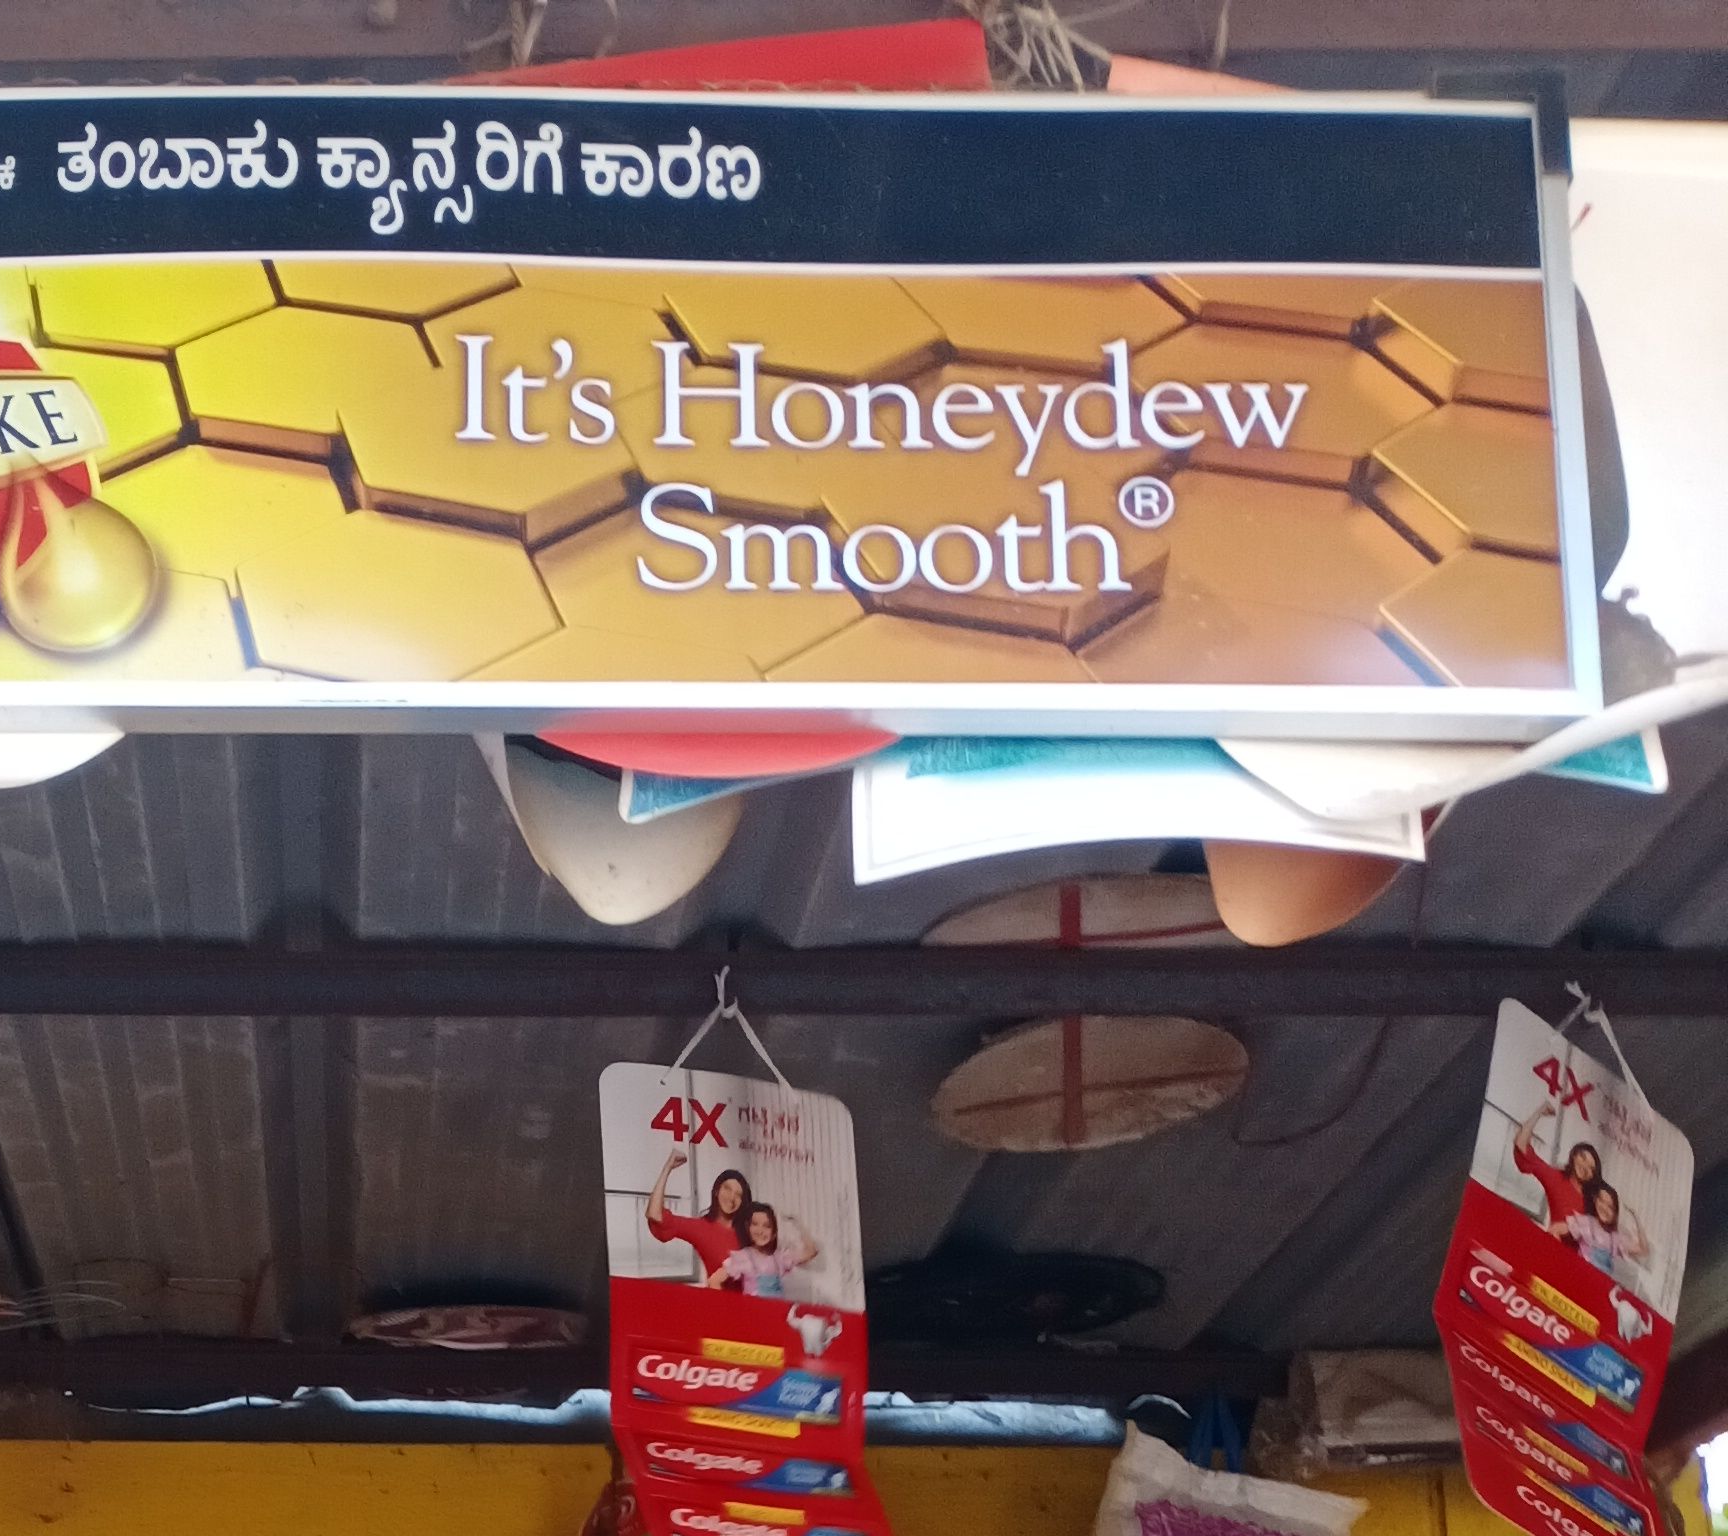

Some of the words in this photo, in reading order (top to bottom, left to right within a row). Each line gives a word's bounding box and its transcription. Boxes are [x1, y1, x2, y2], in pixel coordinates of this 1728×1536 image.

[56, 121, 300, 191] ತಂಬಾಕು
[315, 121, 566, 233] ಕ್ಯಾನ್ಸರಿಗೆ
[580, 126, 762, 200] ಕಾರಣ
[652, 339, 1310, 477] Honeydew
[650, 1096, 729, 1148] 4X
[1532, 1057, 1595, 1121] 4X
[1469, 1265, 1573, 1346] Colgate
[637, 1355, 760, 1393] Colgate
[1458, 1341, 1559, 1420] Colgate
[645, 1442, 764, 1477] Colgate
[1475, 1405, 1574, 1483] Colgate
